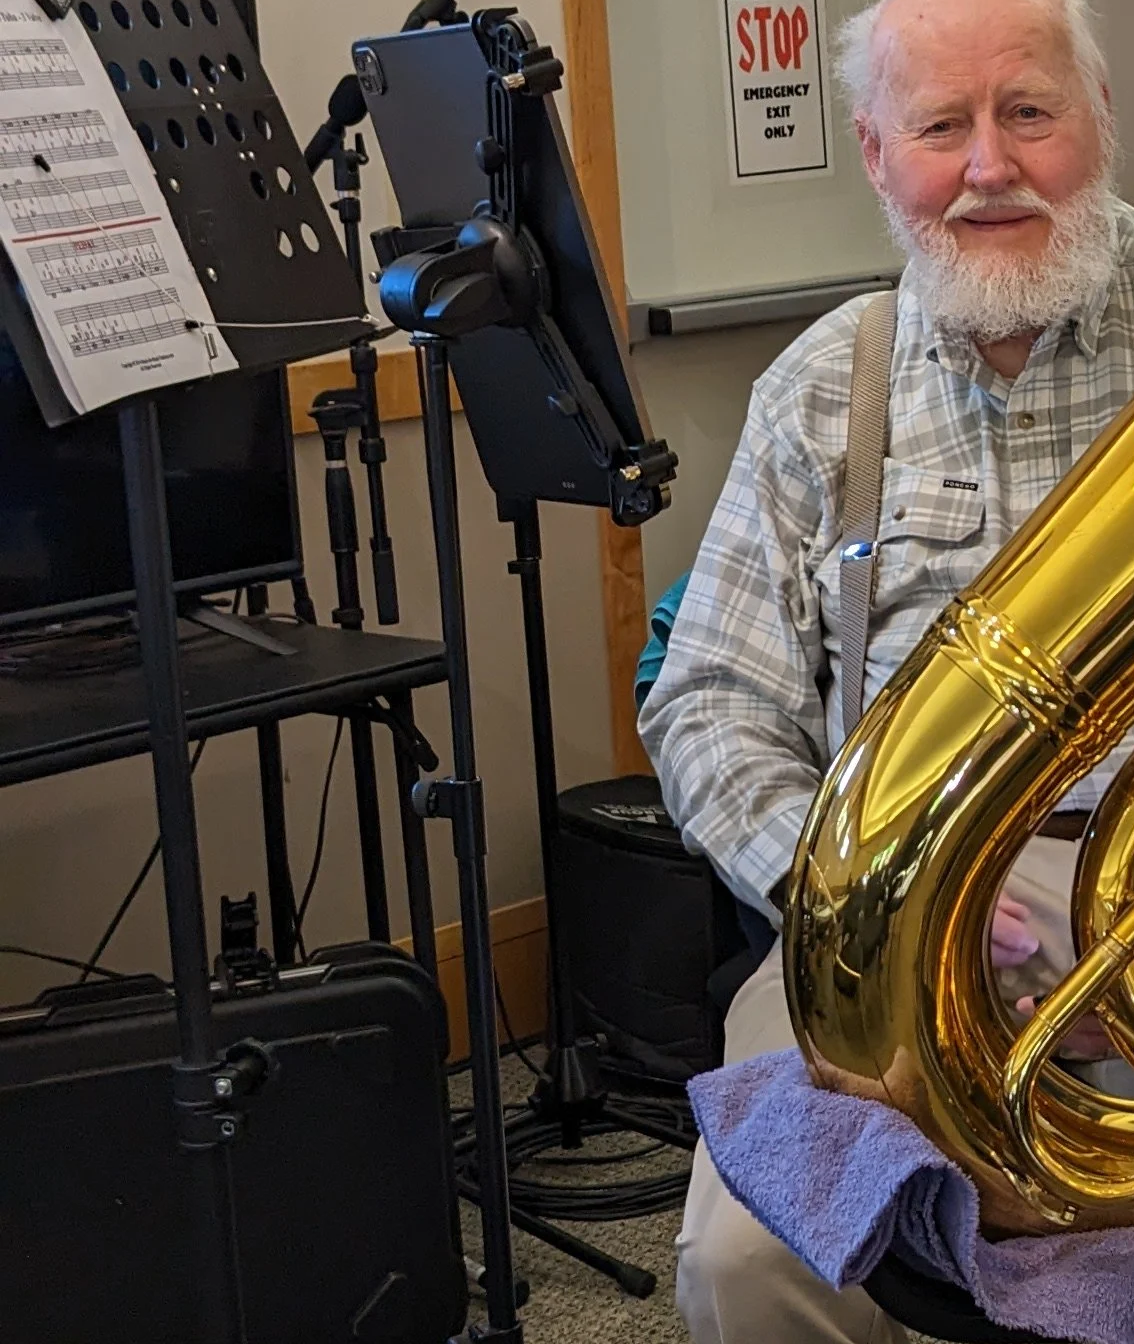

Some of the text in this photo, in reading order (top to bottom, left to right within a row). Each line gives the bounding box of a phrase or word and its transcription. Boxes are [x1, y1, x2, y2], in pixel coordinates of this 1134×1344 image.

[735, 3, 810, 74] STOP
[743, 83, 810, 101] EMERGENCY
[766, 105, 791, 119] EXIT
[764, 124, 796, 139] ONLY
